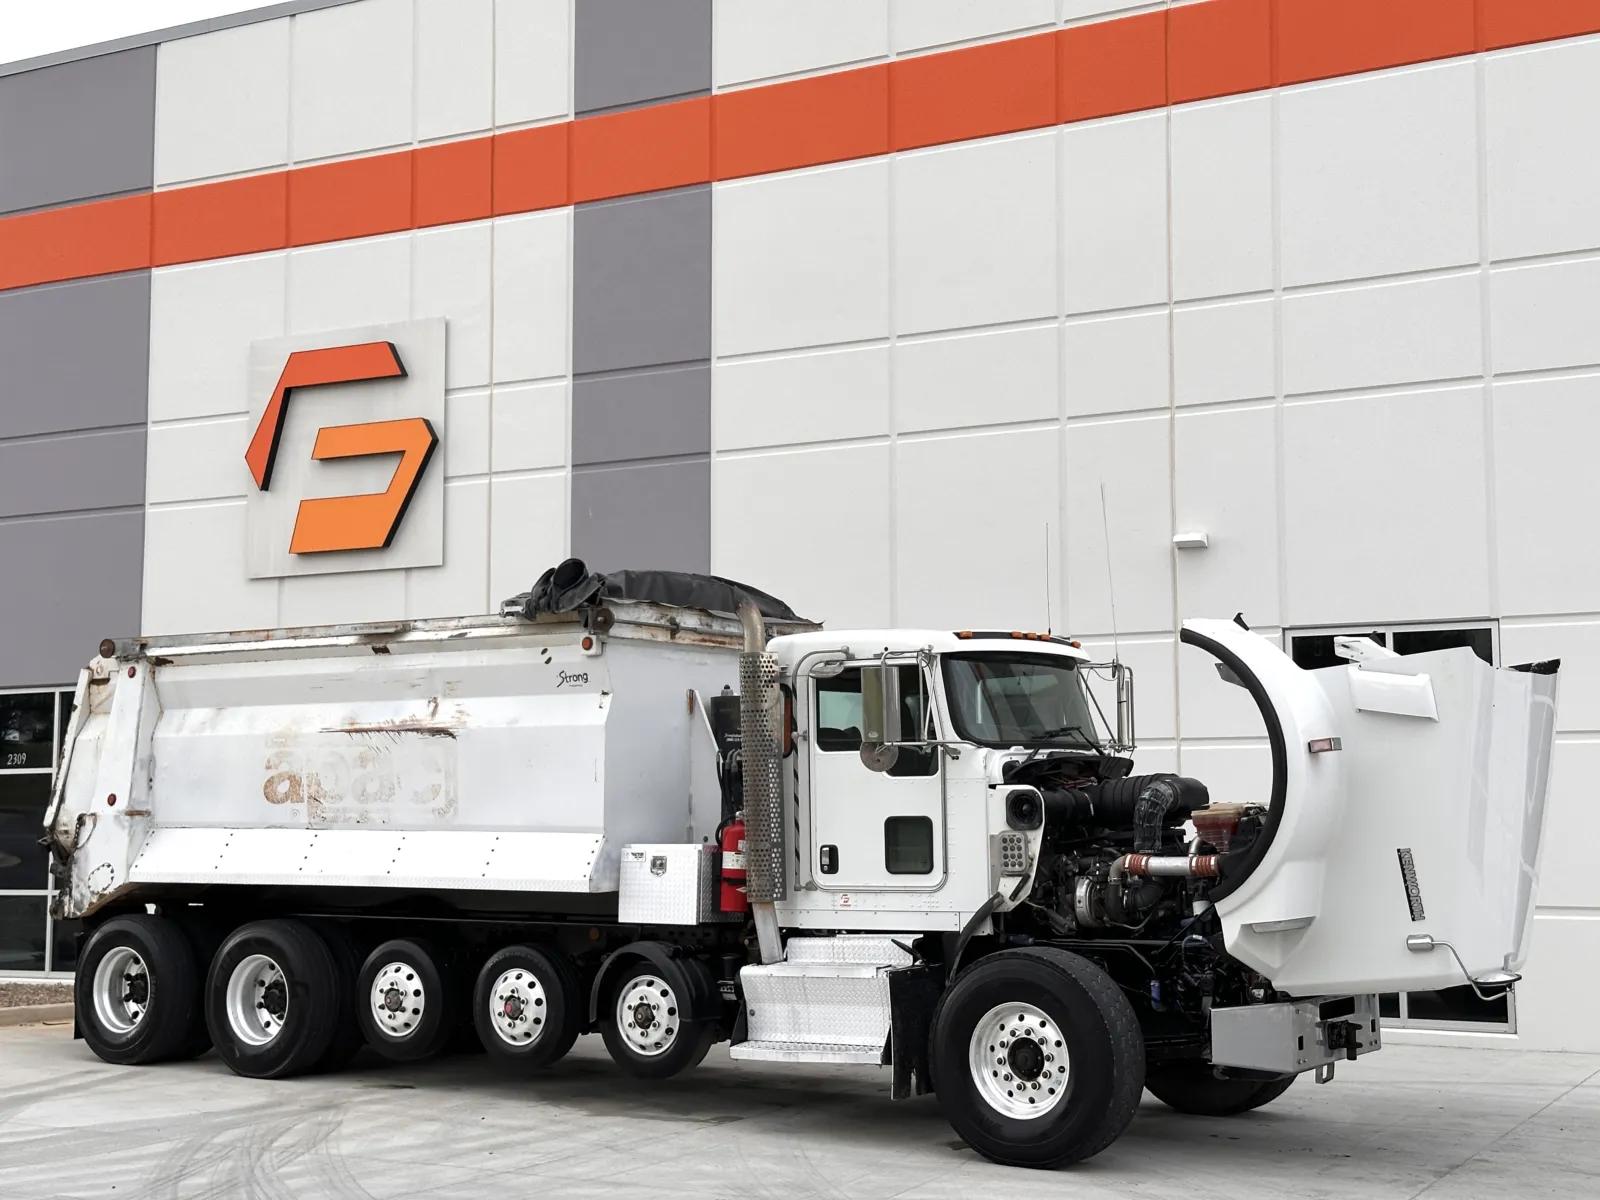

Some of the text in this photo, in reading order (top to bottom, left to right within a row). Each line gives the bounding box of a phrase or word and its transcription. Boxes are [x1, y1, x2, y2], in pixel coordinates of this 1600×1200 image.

[556, 670, 589, 688] Strong
[7, 752, 27, 765] 2309
[1397, 848, 1426, 921] KENWORTH
